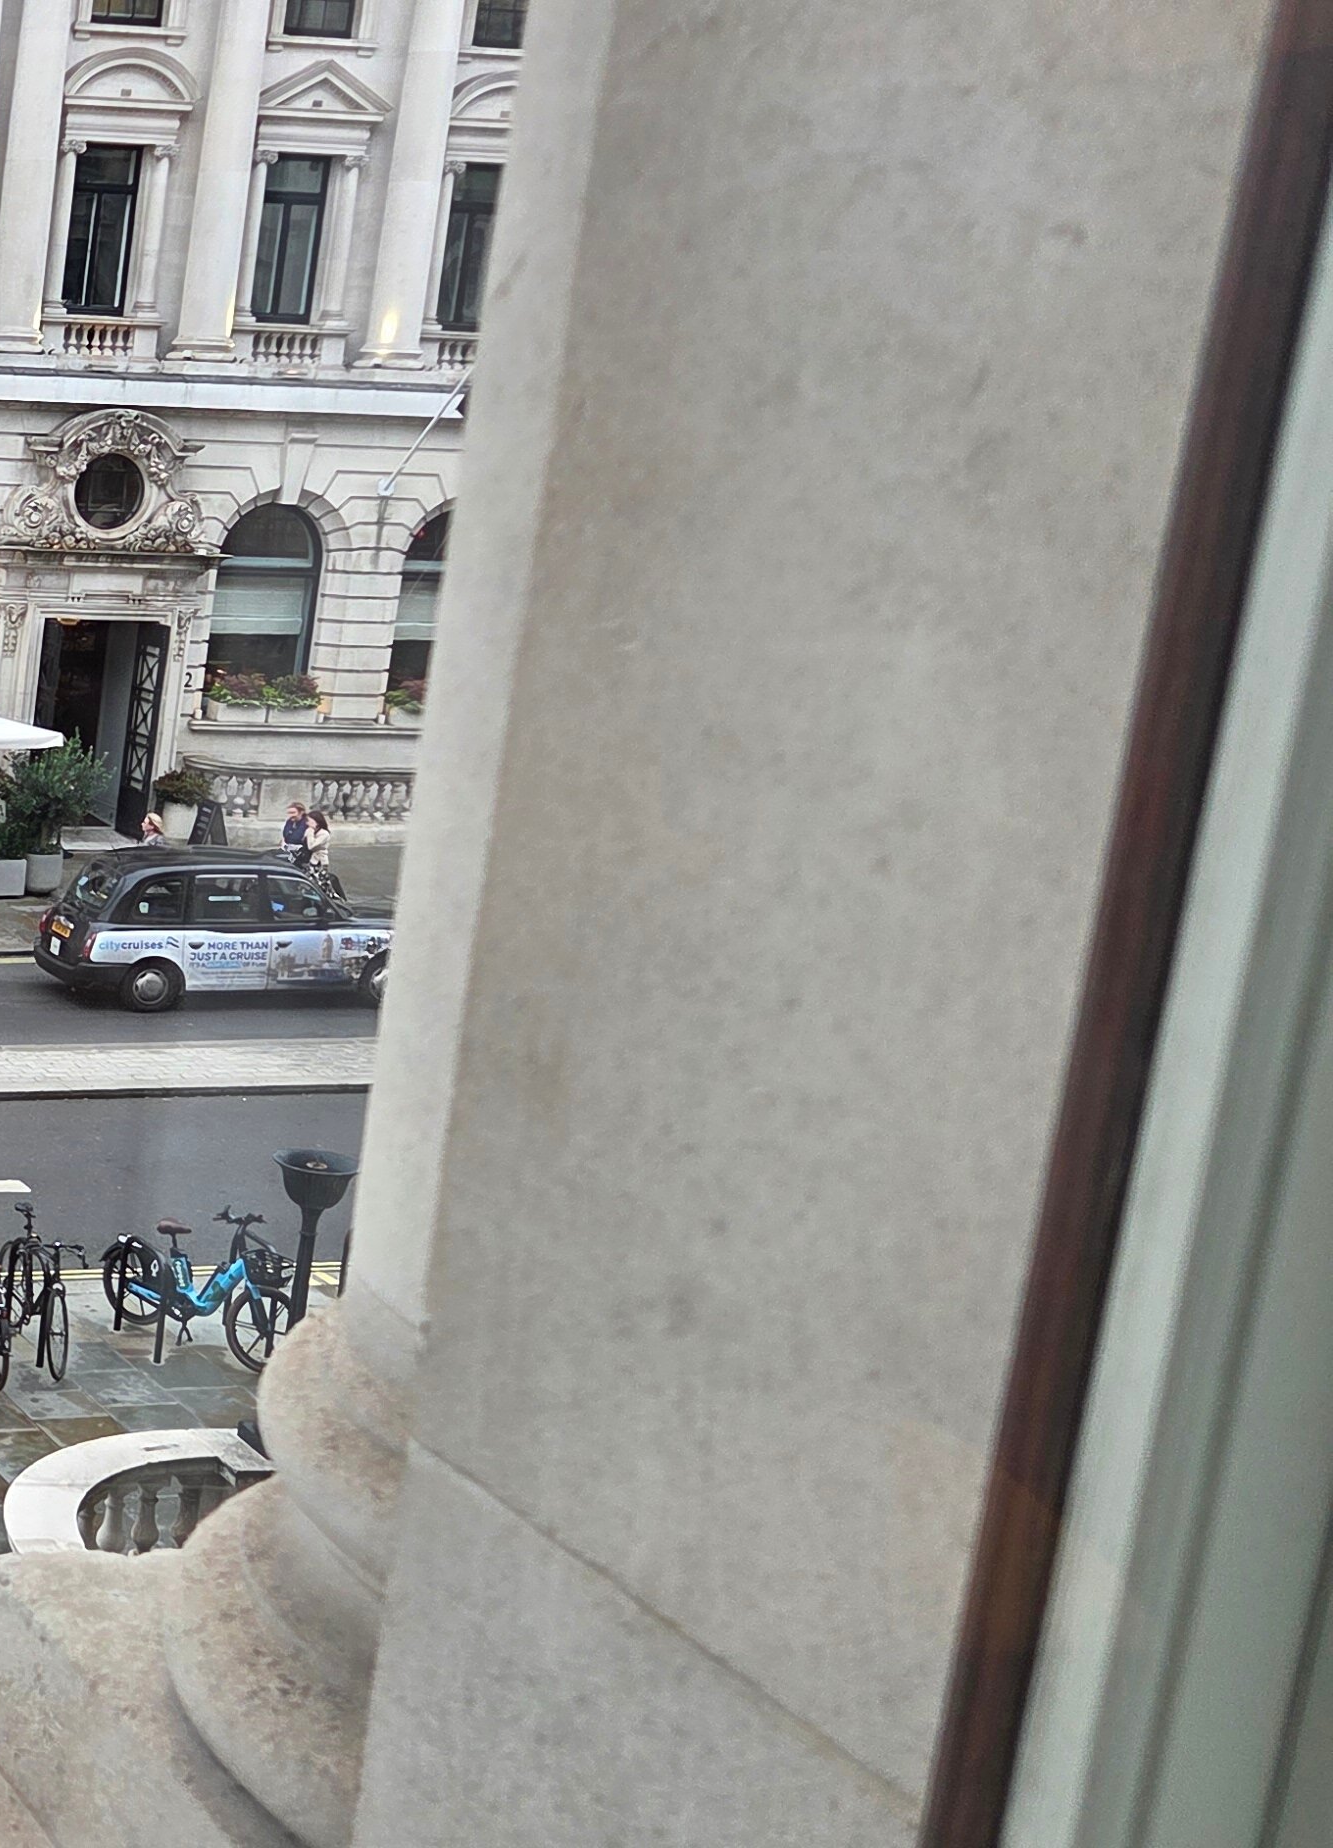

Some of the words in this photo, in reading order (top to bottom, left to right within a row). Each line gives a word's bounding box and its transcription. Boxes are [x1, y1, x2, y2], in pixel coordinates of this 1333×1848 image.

[207, 941, 238, 951] MORE
[240, 941, 269, 950] THAN
[189, 952, 218, 961] JUST
[219, 952, 227, 960] A
[229, 952, 268, 961] CRUISE
